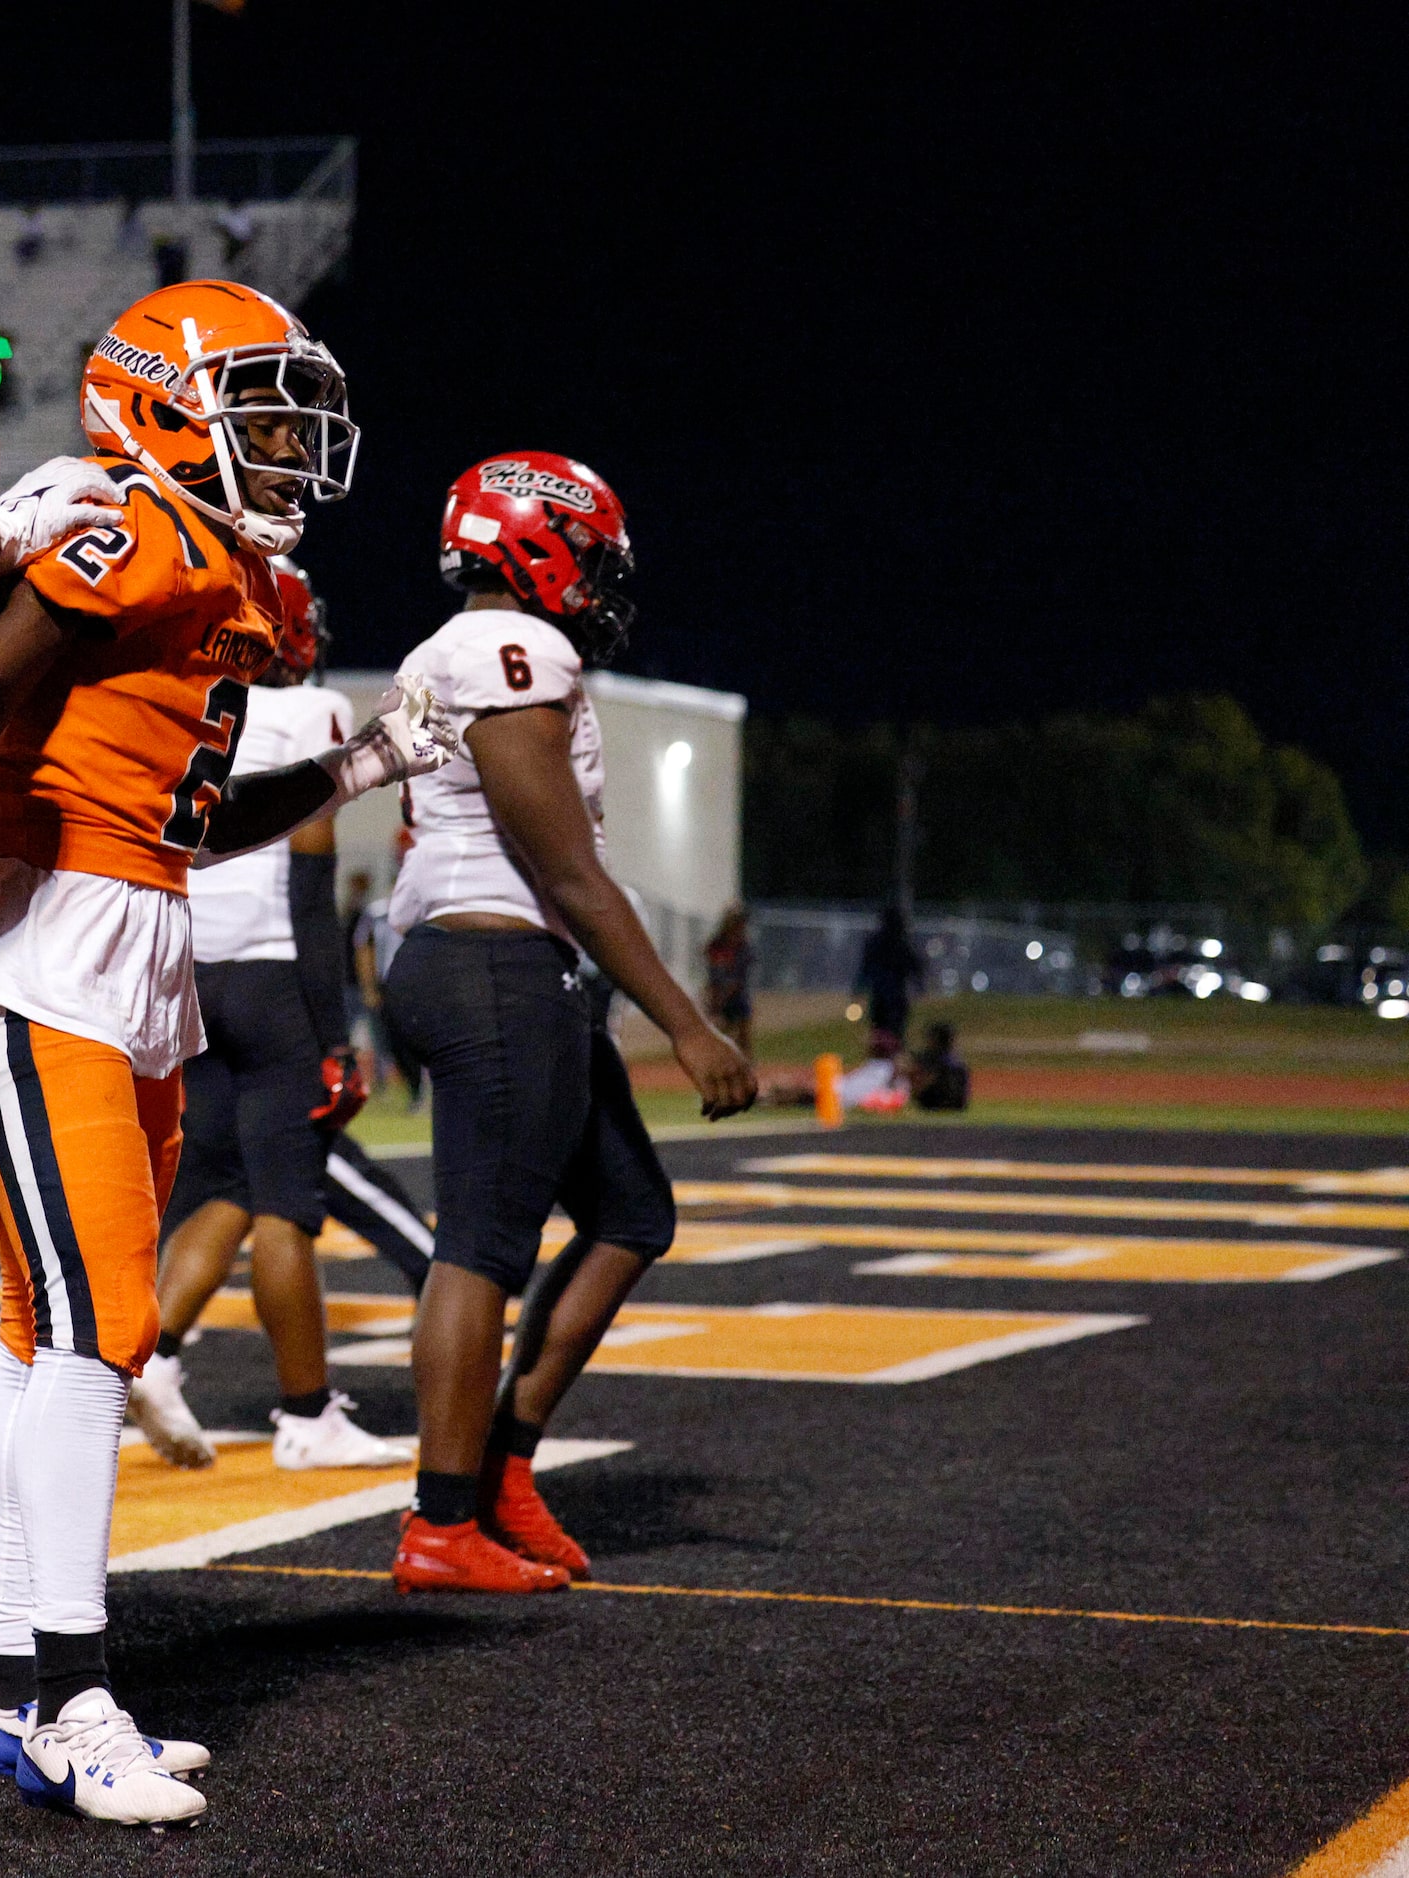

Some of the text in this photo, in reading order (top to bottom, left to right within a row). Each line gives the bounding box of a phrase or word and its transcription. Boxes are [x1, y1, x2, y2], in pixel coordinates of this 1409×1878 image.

[93, 327, 180, 391] ancaster
[478, 460, 593, 504] Horns
[55, 526, 134, 588] 2
[498, 643, 534, 692] 6
[160, 674, 249, 853] 2
